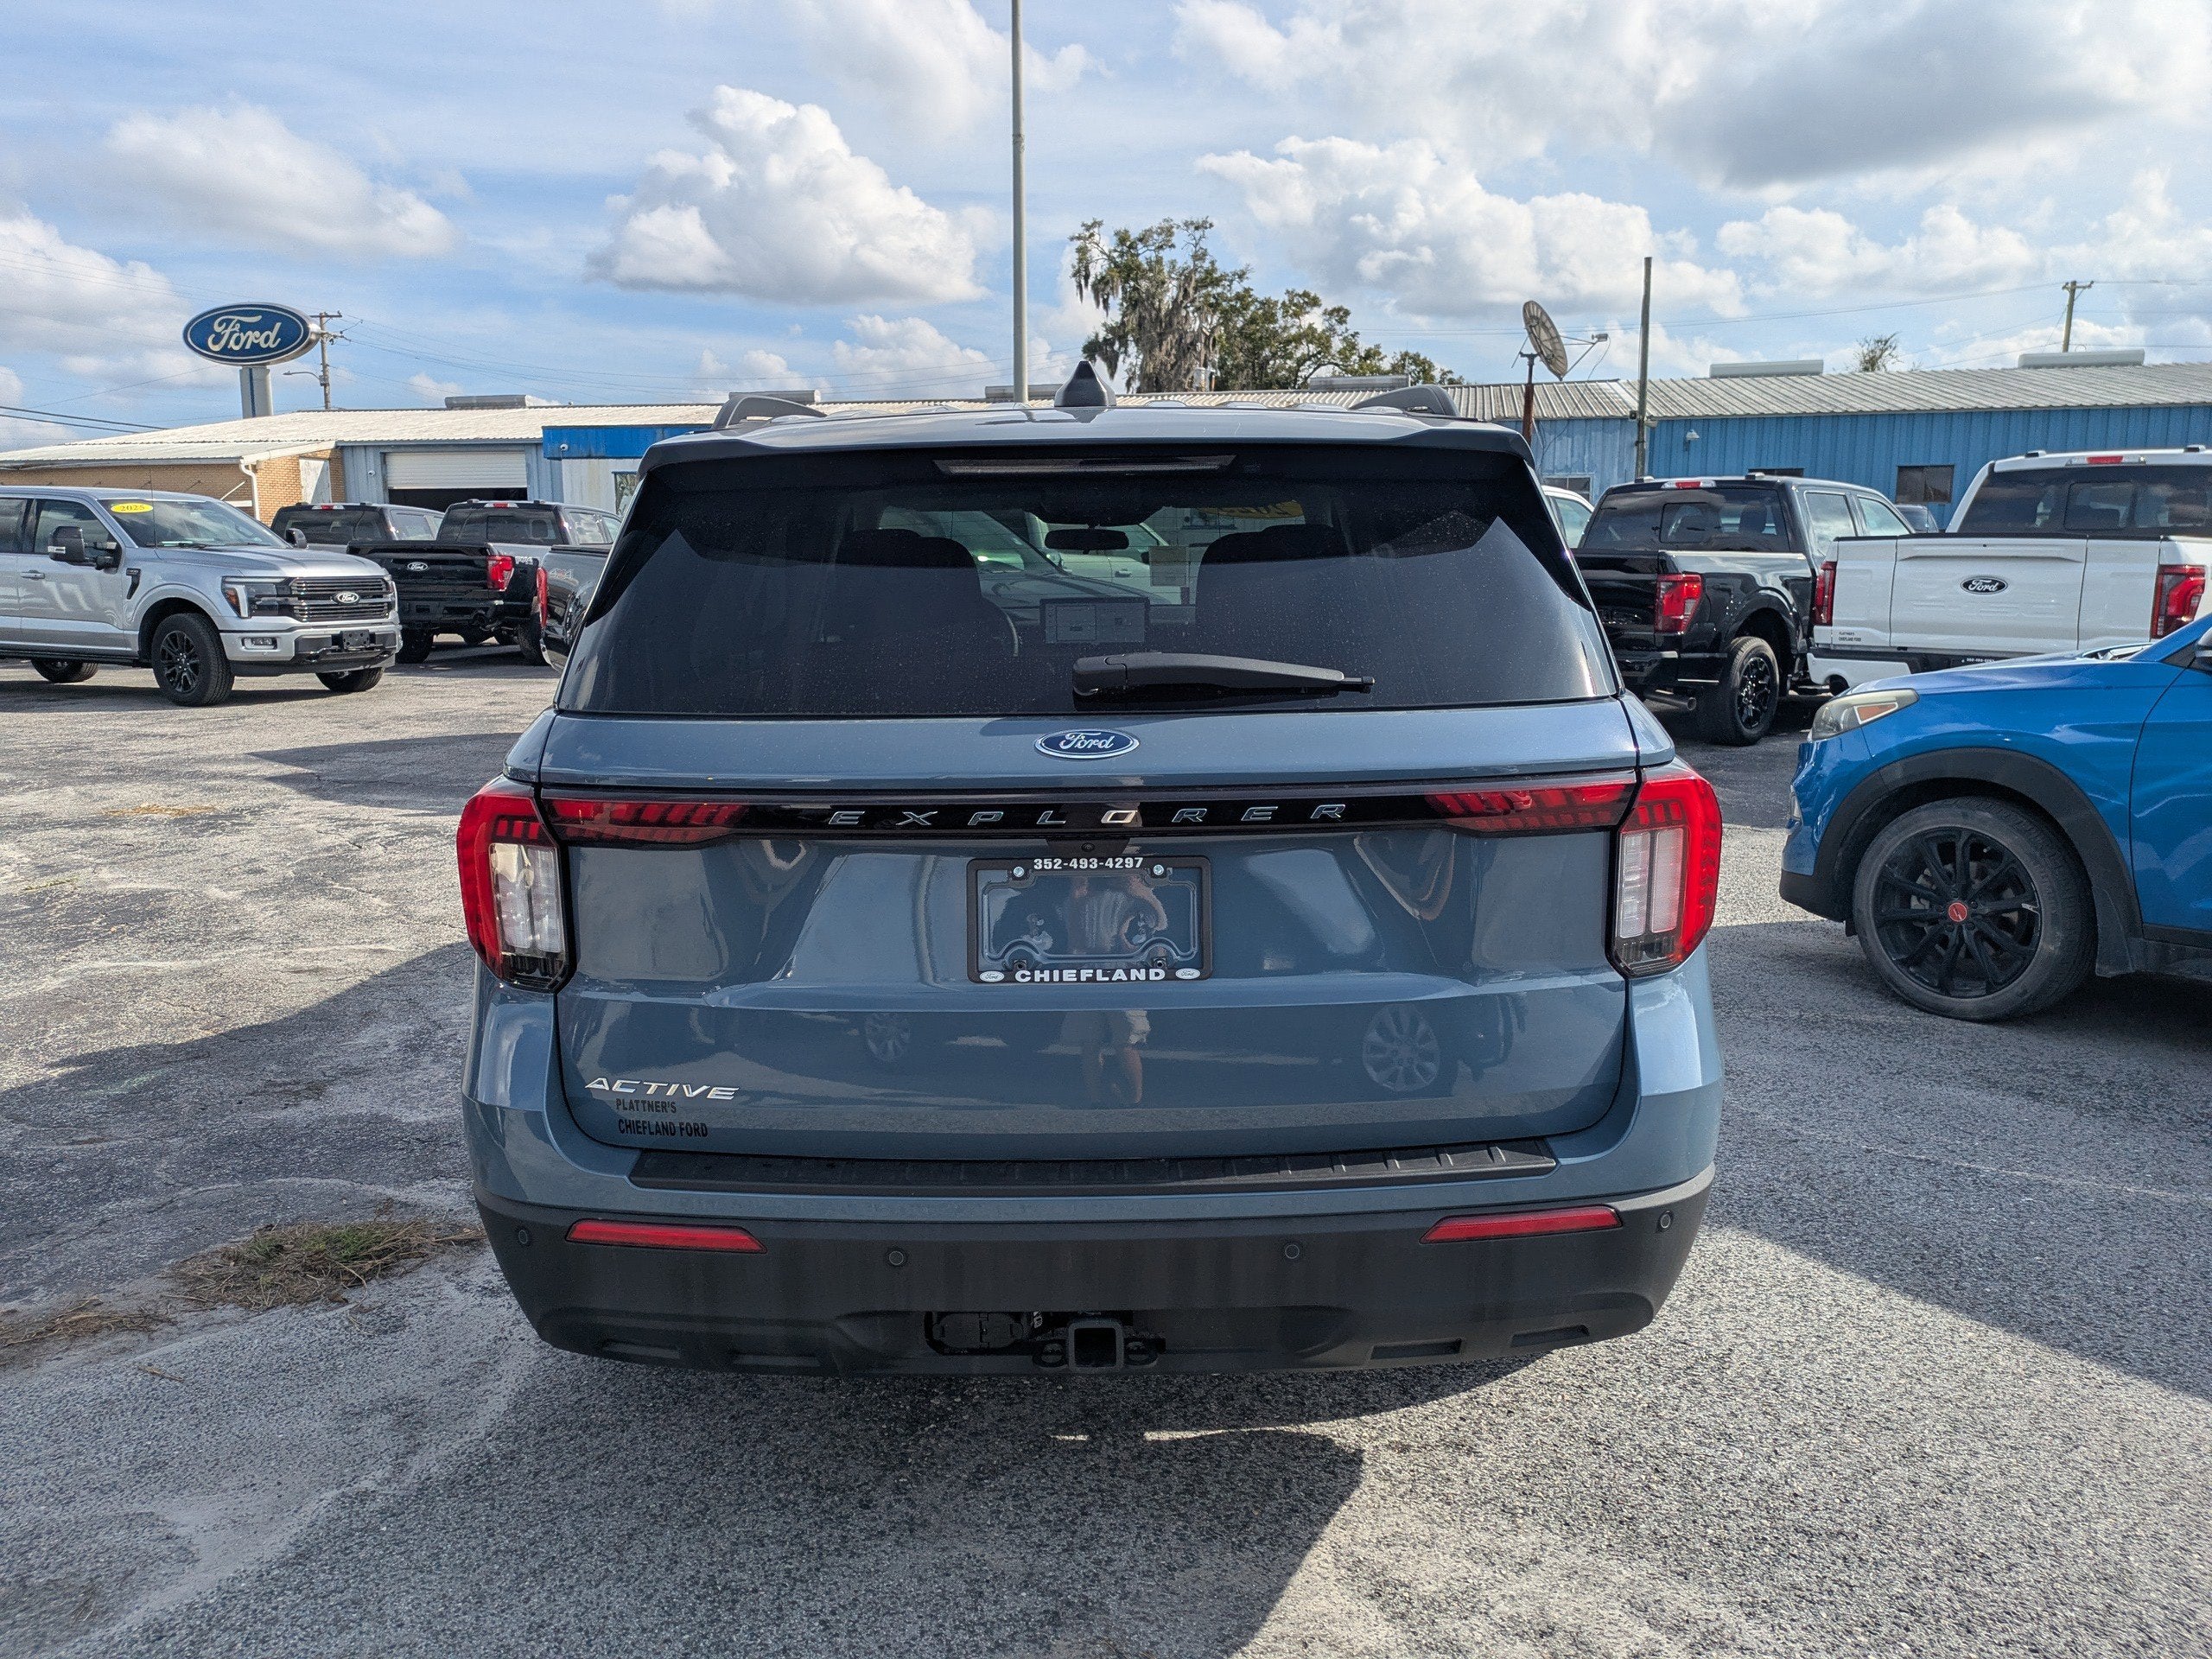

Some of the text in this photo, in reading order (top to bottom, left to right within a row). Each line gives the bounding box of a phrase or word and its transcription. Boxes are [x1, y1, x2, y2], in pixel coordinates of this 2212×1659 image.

[207, 315, 282, 352] Ford
[1968, 579, 1999, 591] Ford
[1058, 732, 1116, 750] Ford
[827, 804, 1346, 826] EXPLORER
[1033, 857, 1144, 870] 352-493-4297
[1014, 968, 1166, 983] CHIEFLAND
[584, 1077, 741, 1101] ACTIVE
[616, 1097, 677, 1115] PLATTNER'S
[618, 1118, 709, 1139] CHIEFLAND FORD
